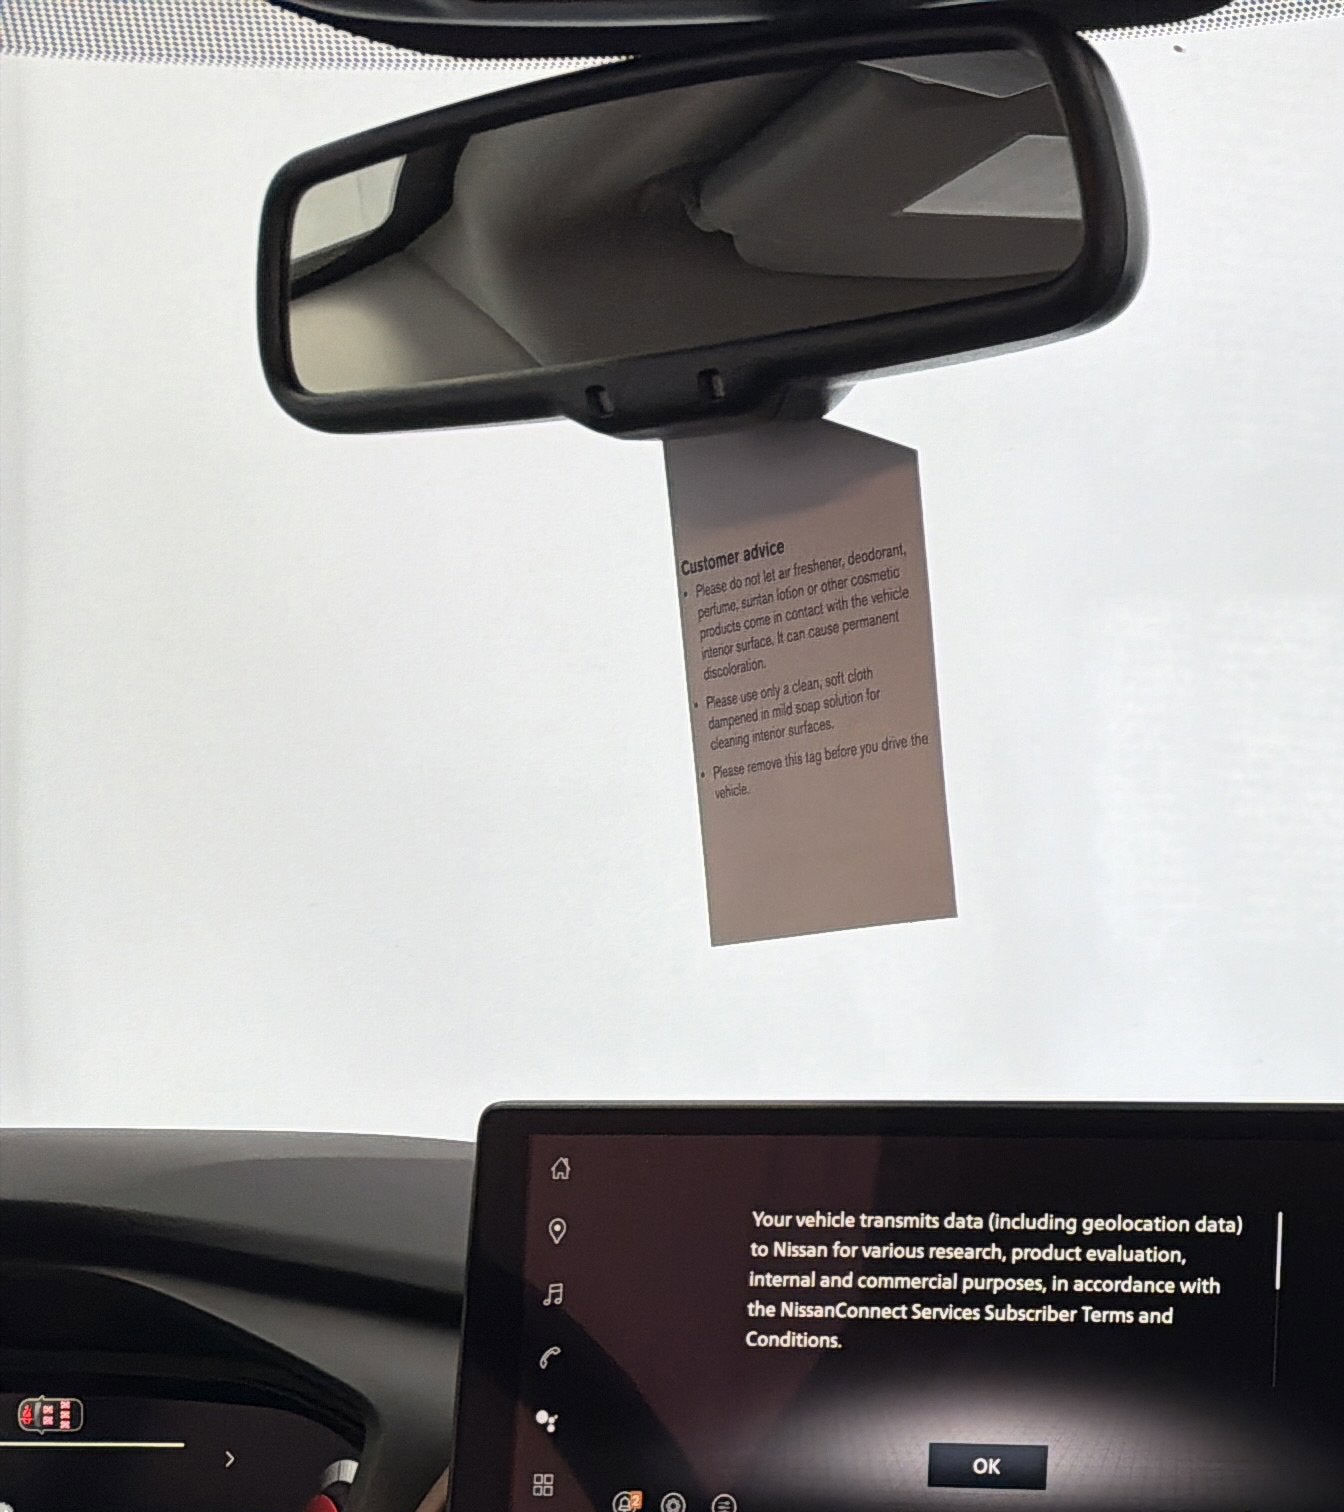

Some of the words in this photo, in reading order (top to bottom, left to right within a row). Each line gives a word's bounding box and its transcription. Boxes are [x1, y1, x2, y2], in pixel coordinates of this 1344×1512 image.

[680, 551, 740, 575] Customer
[742, 541, 785, 561] advice
[695, 581, 728, 597] Please
[728, 575, 743, 590] do
[743, 571, 762, 587] not
[762, 568, 776, 583] let
[777, 567, 791, 580] air
[705, 694, 738, 709] Please
[739, 690, 759, 703] use
[759, 683, 781, 701] only
[782, 683, 790, 695] a
[824, 671, 846, 687] soft
[846, 667, 874, 683] cloth
[709, 733, 750, 750] cleaning
[751, 725, 786, 742] interior
[712, 764, 745, 779] Please
[746, 757, 783, 773] remove
[783, 752, 803, 767] this
[804, 751, 823, 766] tag
[823, 745, 858, 760] before
[859, 741, 879, 759] you
[880, 737, 908, 751] drive
[909, 733, 929, 746] the
[751, 1210, 794, 1227] Your
[794, 1211, 856, 1228] vehicle
[858, 1212, 940, 1228] transmits
[942, 1212, 984, 1229] data
[987, 1213, 1078, 1234] (including
[1081, 1214, 1190, 1235] geolocation
[1194, 1215, 1243, 1235] data)
[749, 1241, 769, 1257] to
[772, 1240, 828, 1257] Nissan
[831, 1240, 860, 1258] for
[860, 1242, 925, 1259] various
[928, 1242, 1007, 1262] research,
[1010, 1243, 1083, 1264] product
[1085, 1244, 1187, 1264] evaluation,
[748, 1271, 816, 1287] internal
[819, 1272, 854, 1288] and
[856, 1273, 958, 1289] commercial
[961, 1277, 1047, 1294] purposes,
[1051, 1274, 1069, 1291] in
[1072, 1275, 1176, 1293] accordance
[1179, 1276, 1221, 1294] with
[746, 1300, 777, 1317] the
[779, 1301, 909, 1319] NissanConnect
[910, 1303, 981, 1320] Services
[983, 1304, 1078, 1322] Subscriber
[1080, 1305, 1135, 1323] Terms
[1137, 1306, 1174, 1324] and
[744, 1330, 842, 1348] Conditions.
[973, 1457, 1001, 1475] OK
